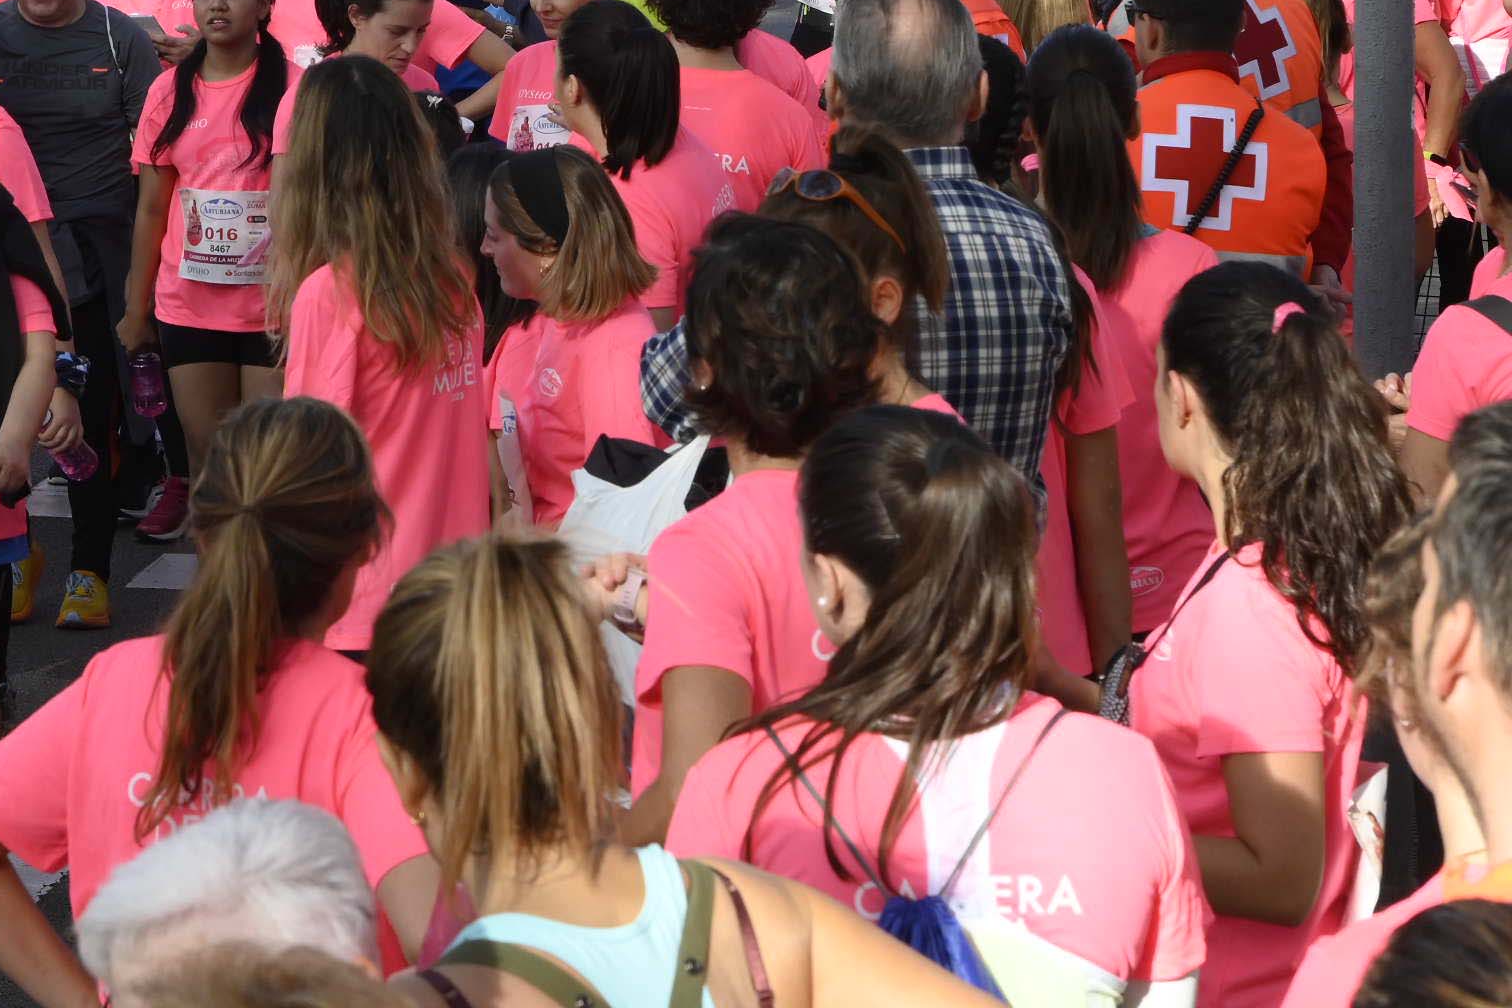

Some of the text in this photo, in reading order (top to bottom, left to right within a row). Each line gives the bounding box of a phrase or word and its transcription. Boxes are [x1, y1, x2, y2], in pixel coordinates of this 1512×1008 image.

[202, 204, 241, 215] ASTURIANA
[205, 227, 238, 241] 016
[209, 244, 231, 254] 8467
[208, 255, 216, 263] DE
[432, 362, 477, 396] MUJE
